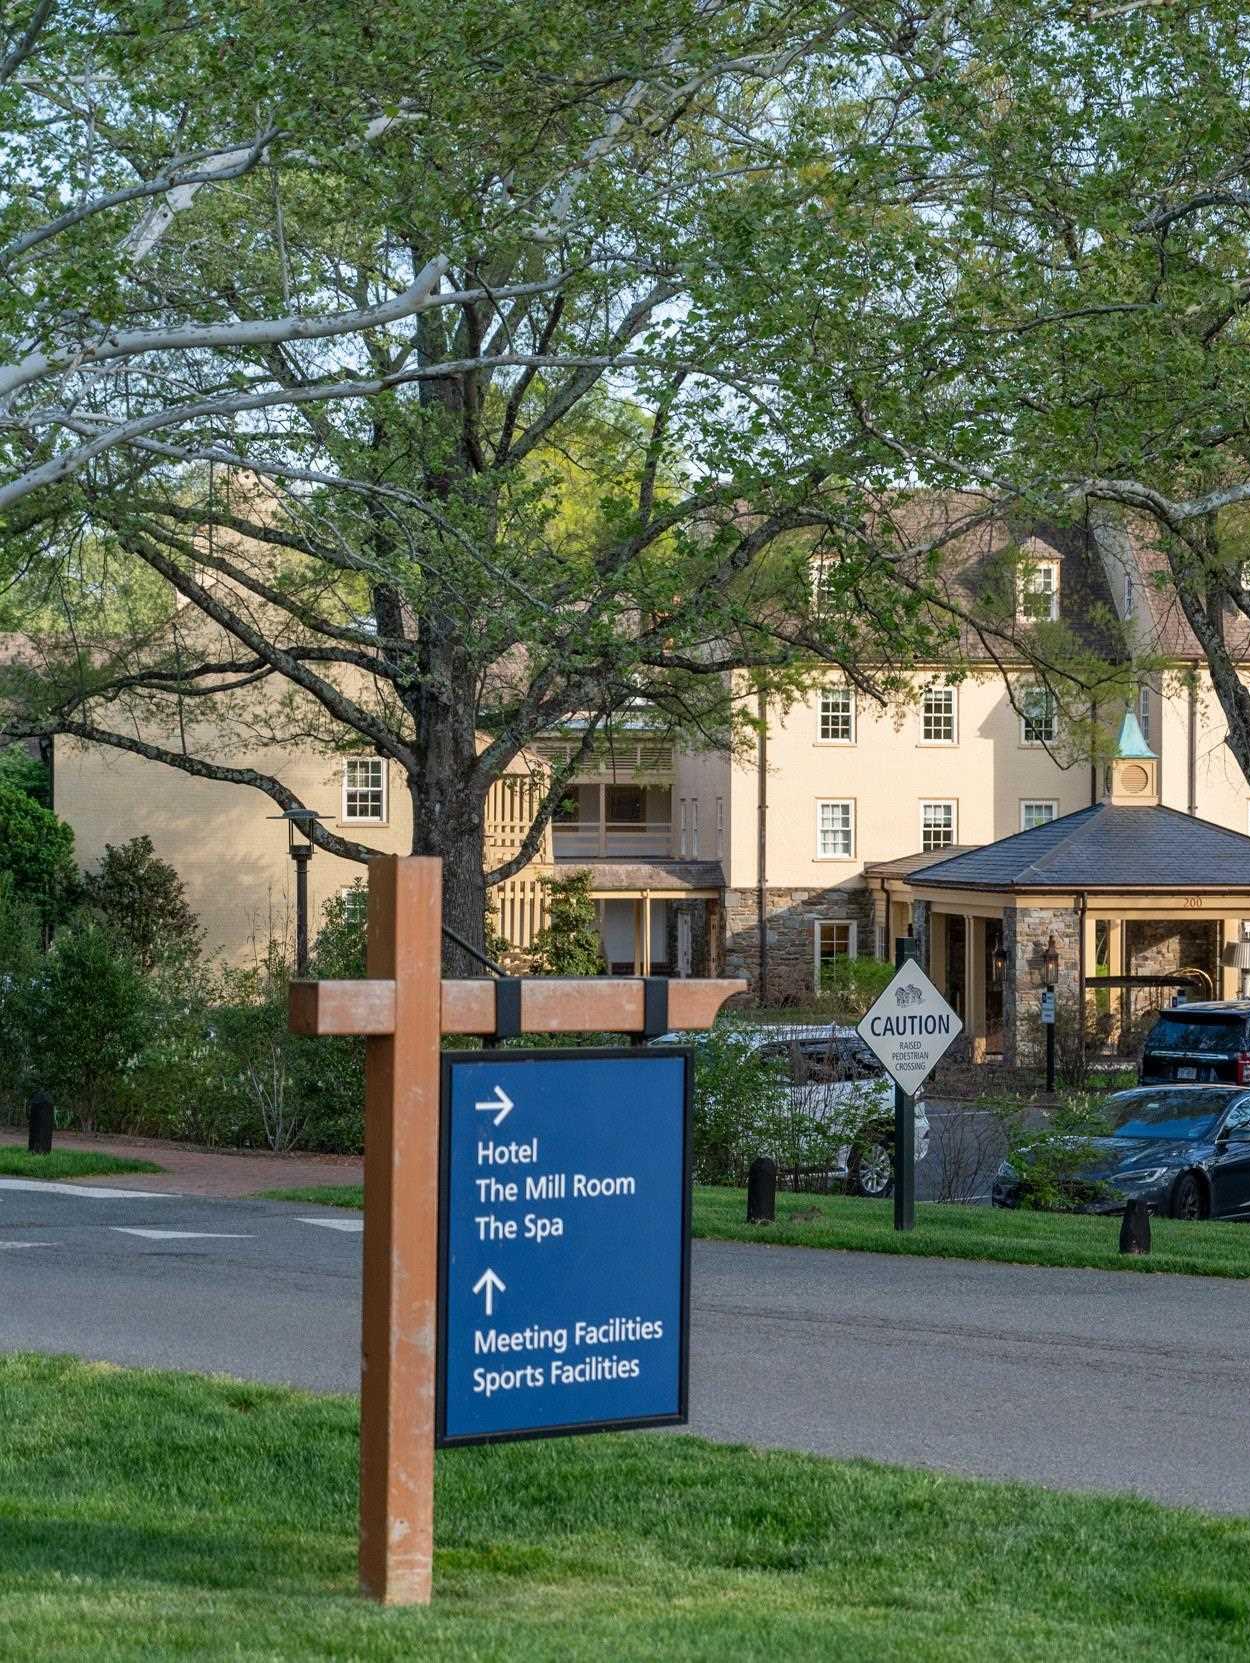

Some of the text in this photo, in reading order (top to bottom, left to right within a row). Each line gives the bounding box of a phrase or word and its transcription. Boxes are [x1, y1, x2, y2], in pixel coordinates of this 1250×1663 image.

[1184, 896, 1202, 908] 200
[871, 1015, 950, 1037] CAUTION
[892, 1051, 928, 1061] PEDESTRIAN
[899, 1041, 921, 1050] RAISED
[895, 1062, 926, 1072] CROSSING
[477, 1138, 538, 1165] Hotel
[476, 1174, 636, 1203] The Mill Room
[475, 1214, 564, 1243] The Spa
[474, 1317, 663, 1354] Meeting Facilities
[473, 1356, 640, 1397] Sports Facilities
